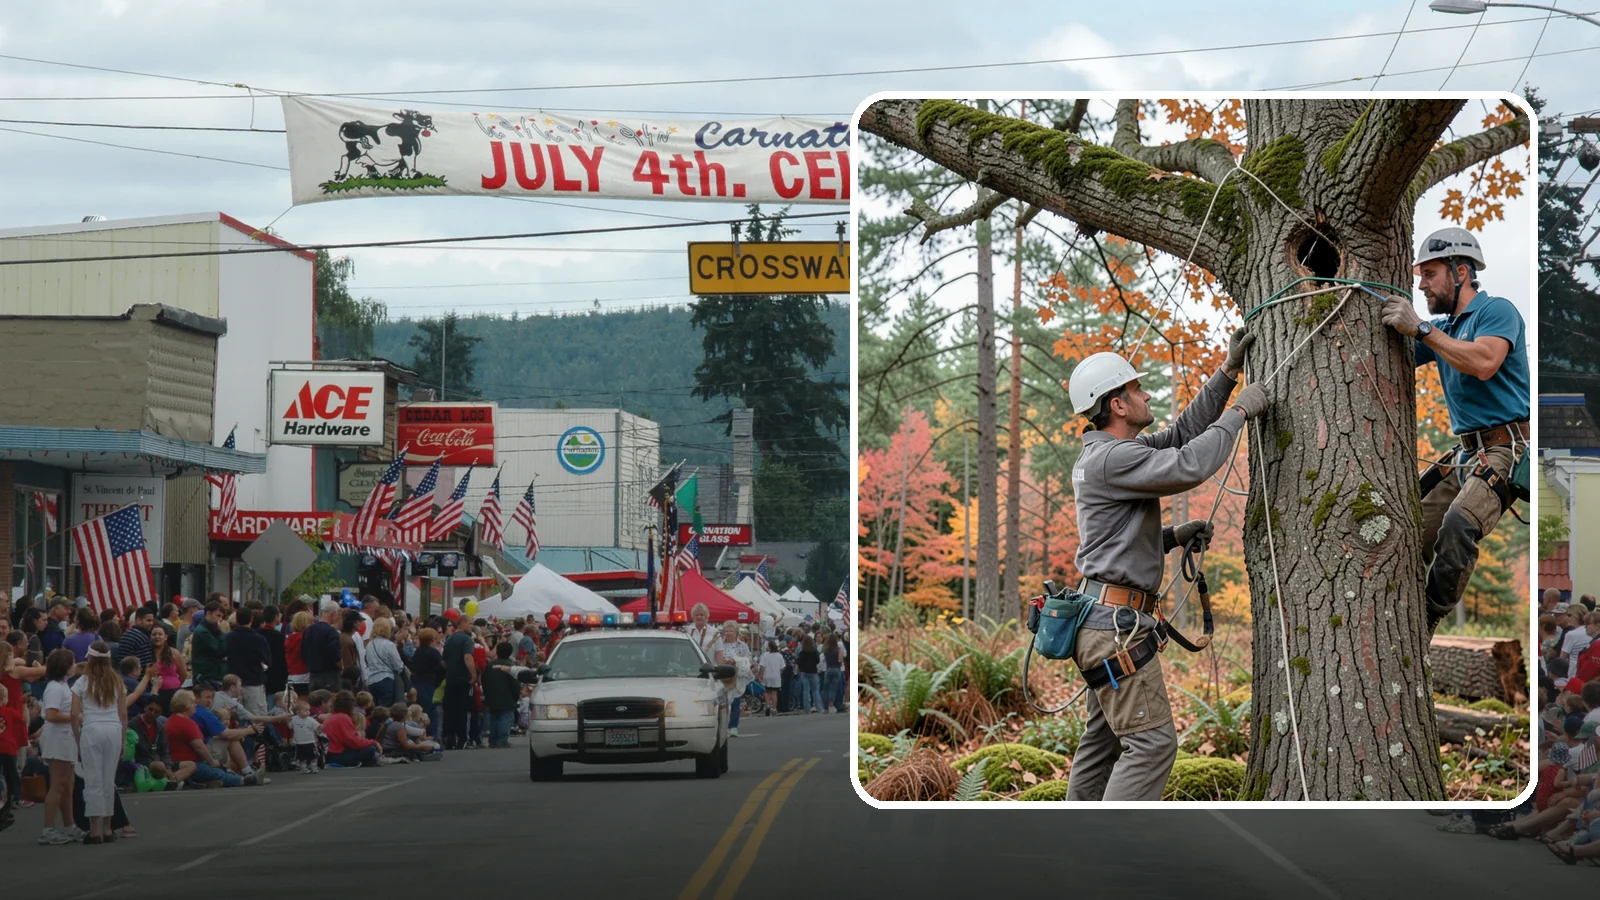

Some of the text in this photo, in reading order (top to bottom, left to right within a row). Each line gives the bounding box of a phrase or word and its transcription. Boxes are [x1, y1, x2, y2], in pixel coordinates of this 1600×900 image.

[481, 141, 605, 192] JULY
[632, 150, 746, 197] 4th.
[697, 254, 850, 279] CROSSWA
[283, 380, 373, 419] ACE
[406, 410, 452, 422] CEDAR
[284, 421, 371, 436] Hardware
[416, 428, 477, 446] Coca-Cola
[95, 485, 124, 495] Vincent
[126, 486, 135, 495] de
[137, 486, 155, 495] Paul
[688, 526, 741, 535] CRNATION
[699, 535, 730, 543] GLASS
